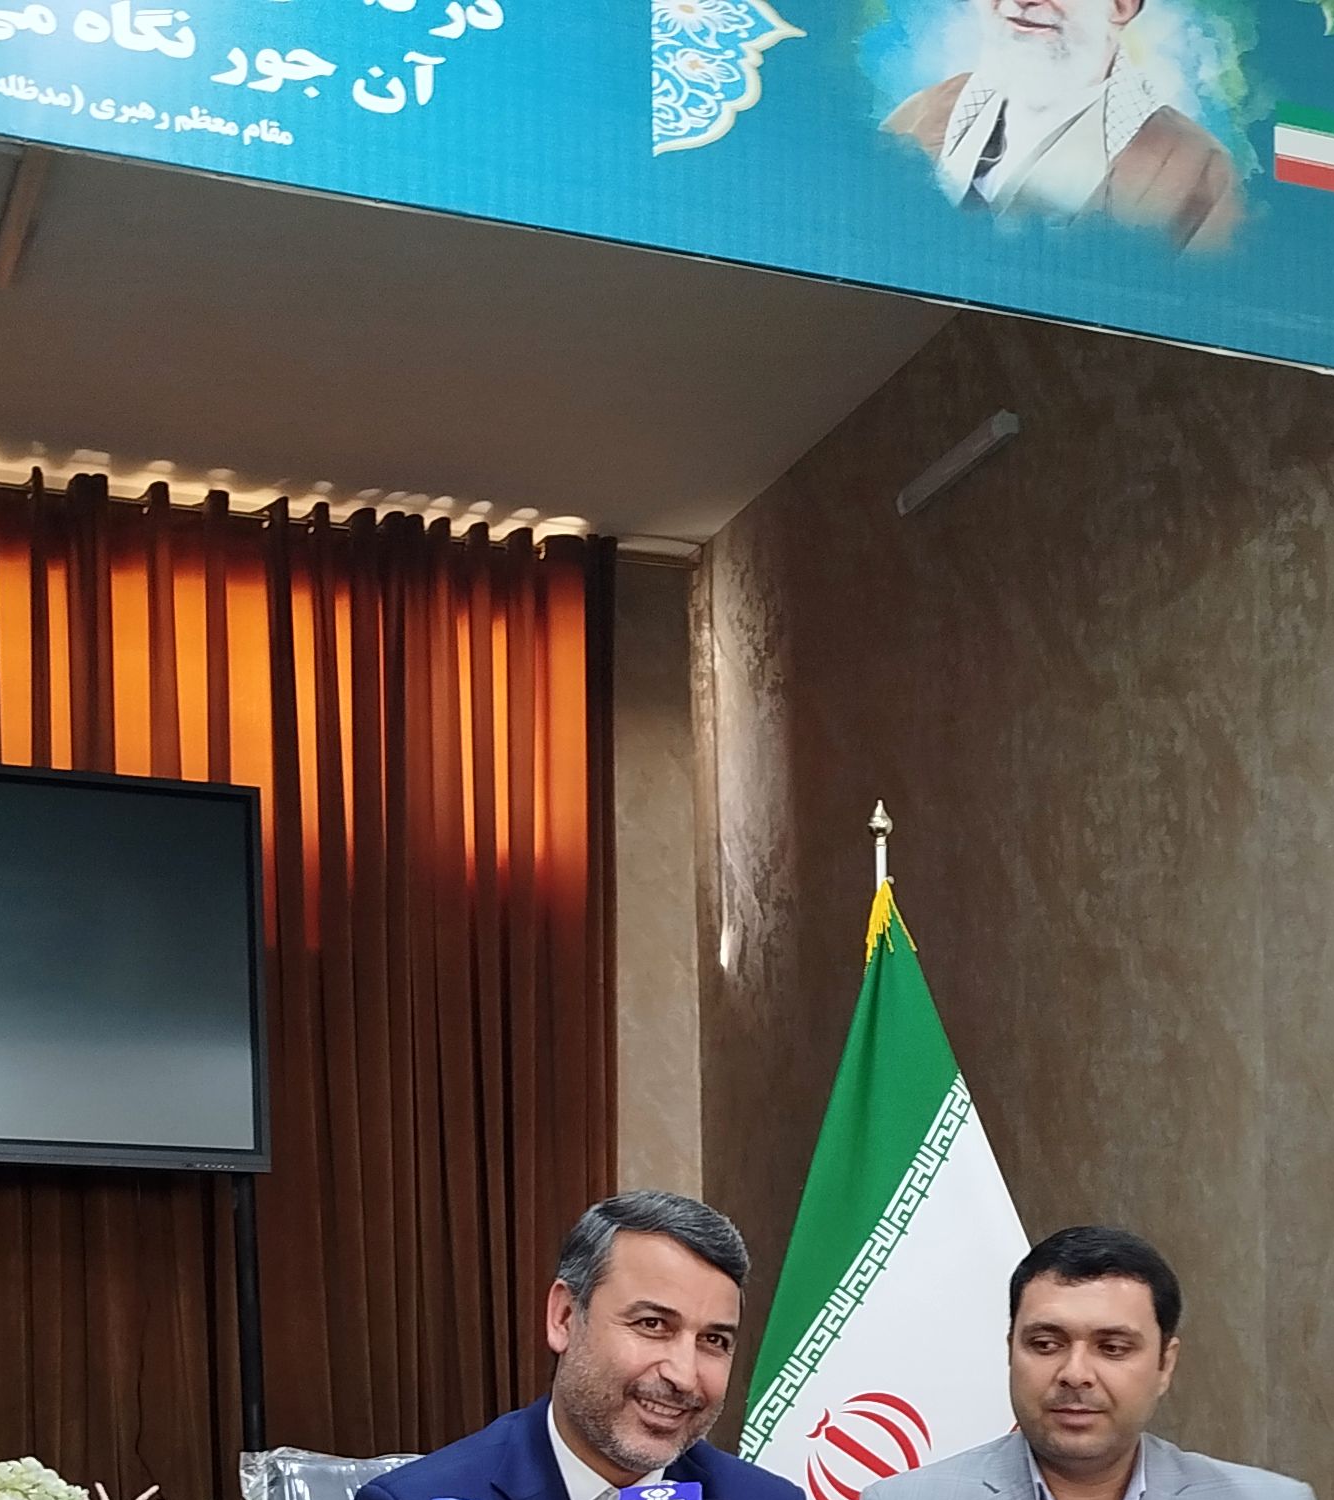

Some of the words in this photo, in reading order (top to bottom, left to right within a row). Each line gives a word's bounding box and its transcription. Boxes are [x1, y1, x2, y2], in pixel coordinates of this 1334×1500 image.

[73, 0, 196, 59] نگاه
[210, 47, 338, 99] جور
[352, 51, 447, 114] آن
[173, 105, 240, 137] معظم
[242, 118, 295, 146] مقام
